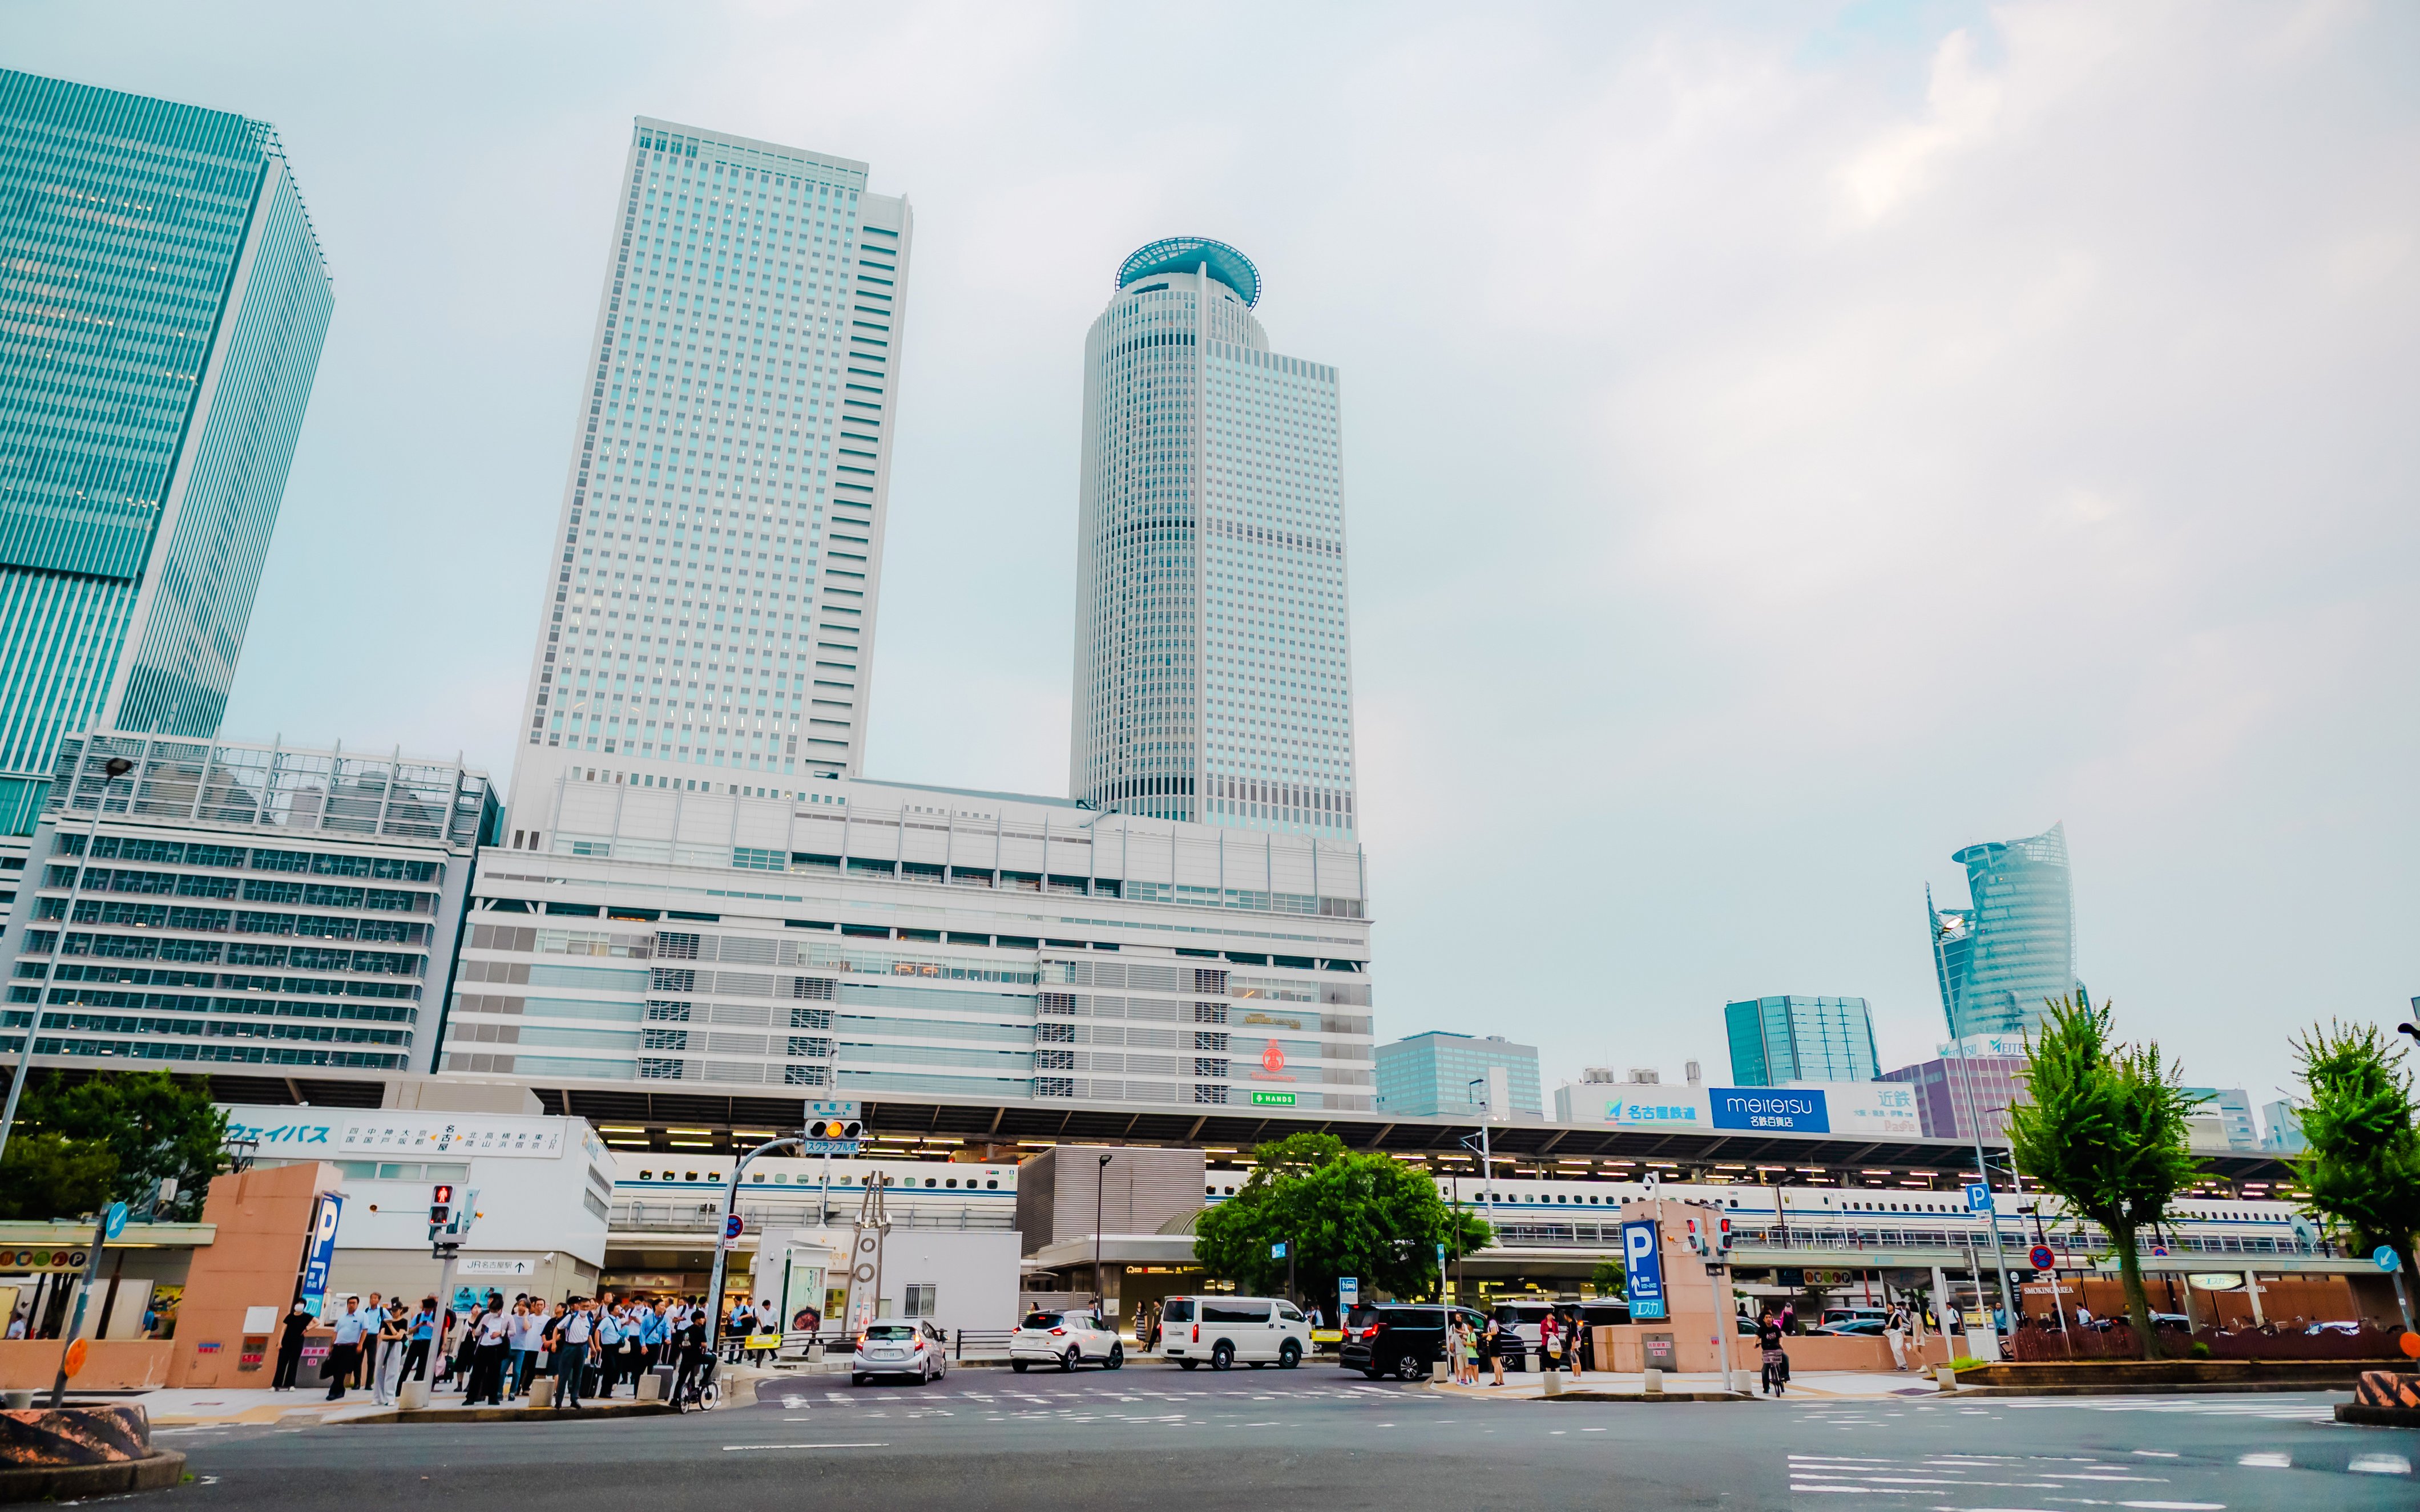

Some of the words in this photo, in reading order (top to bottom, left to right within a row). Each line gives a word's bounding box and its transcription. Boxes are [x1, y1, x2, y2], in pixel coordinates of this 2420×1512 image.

[1878, 1091, 1911, 1107] 近鉄
[1627, 1105, 1697, 1120] 名古屋鉄道
[1750, 1116, 1794, 1127] 名鉄百貨店
[362, 1128, 377, 1143] 中国
[380, 1129, 394, 1144] 神戸
[397, 1129, 411, 1145] 大阪
[437, 1125, 455, 1151] 名古屋
[531, 1134, 543, 1150] 東京
[1971, 1187, 1986, 1208] P
[313, 1200, 338, 1258] P
[1626, 1227, 1653, 1272] P
[72, 1254, 83, 1265] P
[1635, 1301, 1659, 1315] エスカ
